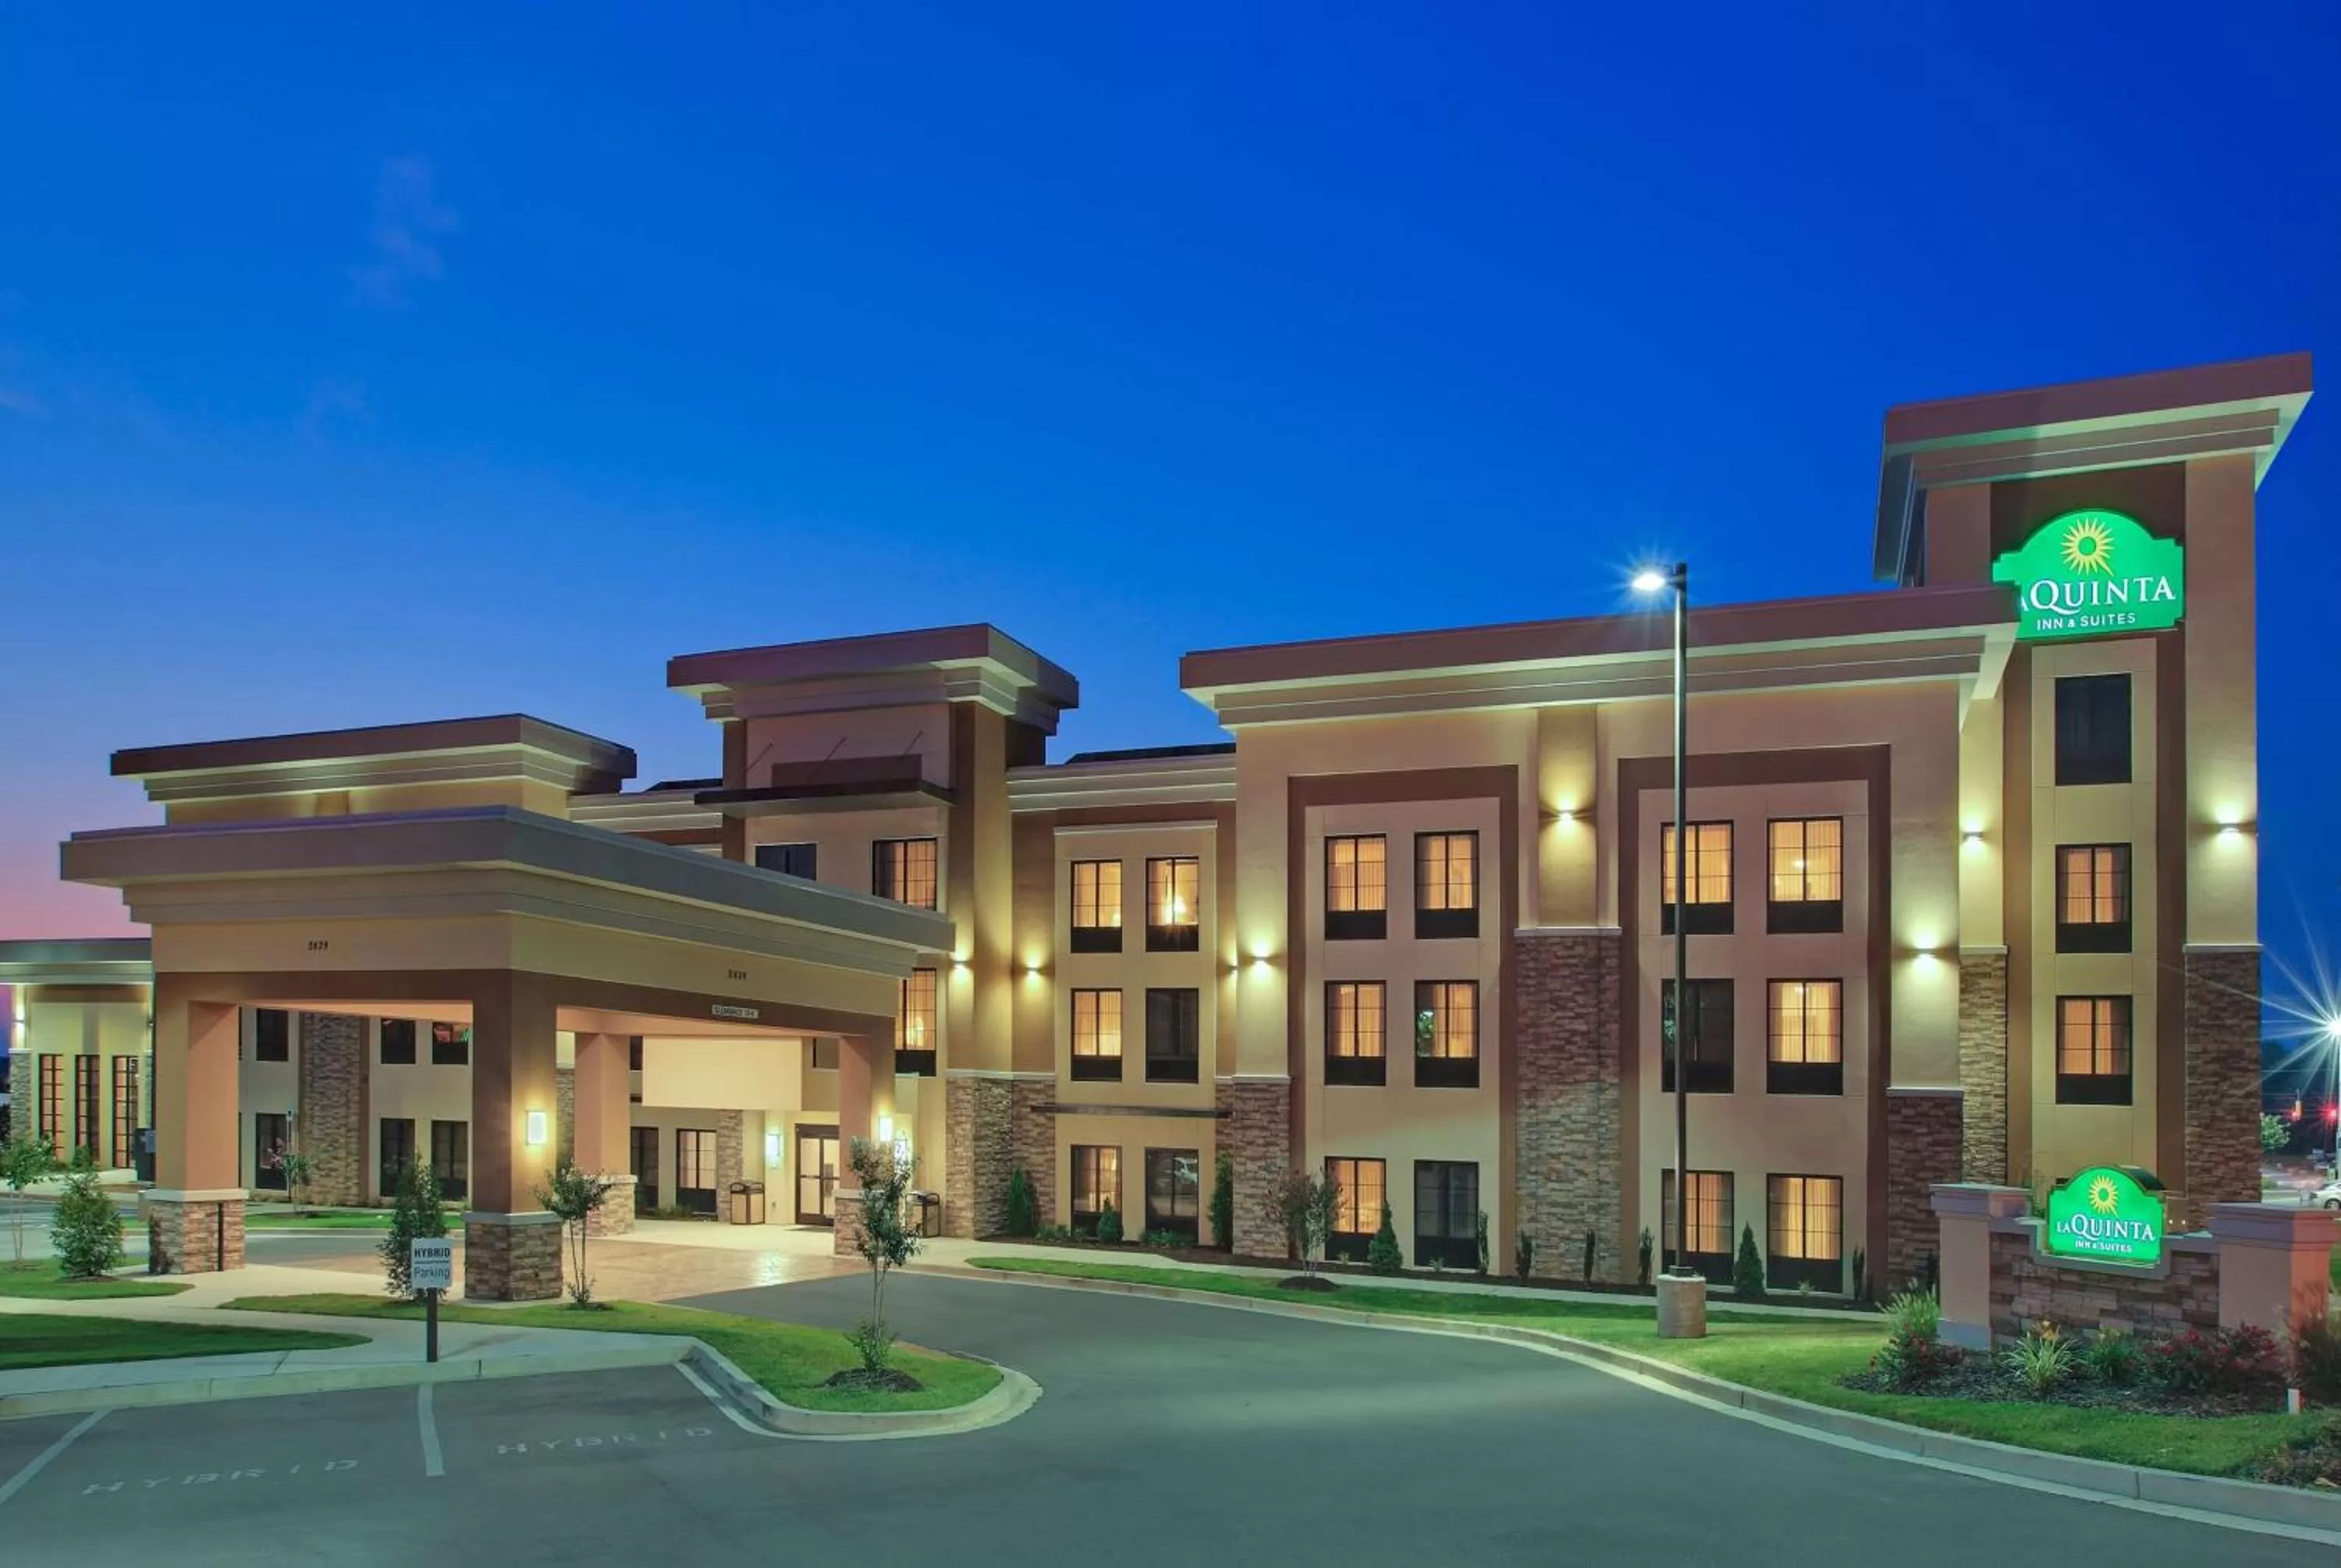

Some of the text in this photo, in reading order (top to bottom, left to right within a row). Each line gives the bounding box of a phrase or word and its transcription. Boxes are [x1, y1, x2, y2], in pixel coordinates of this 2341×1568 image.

[2030, 575, 2176, 615] QUINTA
[2037, 612, 2136, 630] INN & SUITES
[2071, 1213, 2155, 1241] QUINTA
[414, 1247, 450, 1258] HYBRID
[2076, 1240, 2091, 1249] INN
[2099, 1242, 2132, 1253] SUITES
[414, 1267, 450, 1280] Parking
[497, 1427, 712, 1454] HYBRID
[82, 1460, 358, 1495] HYBRID
